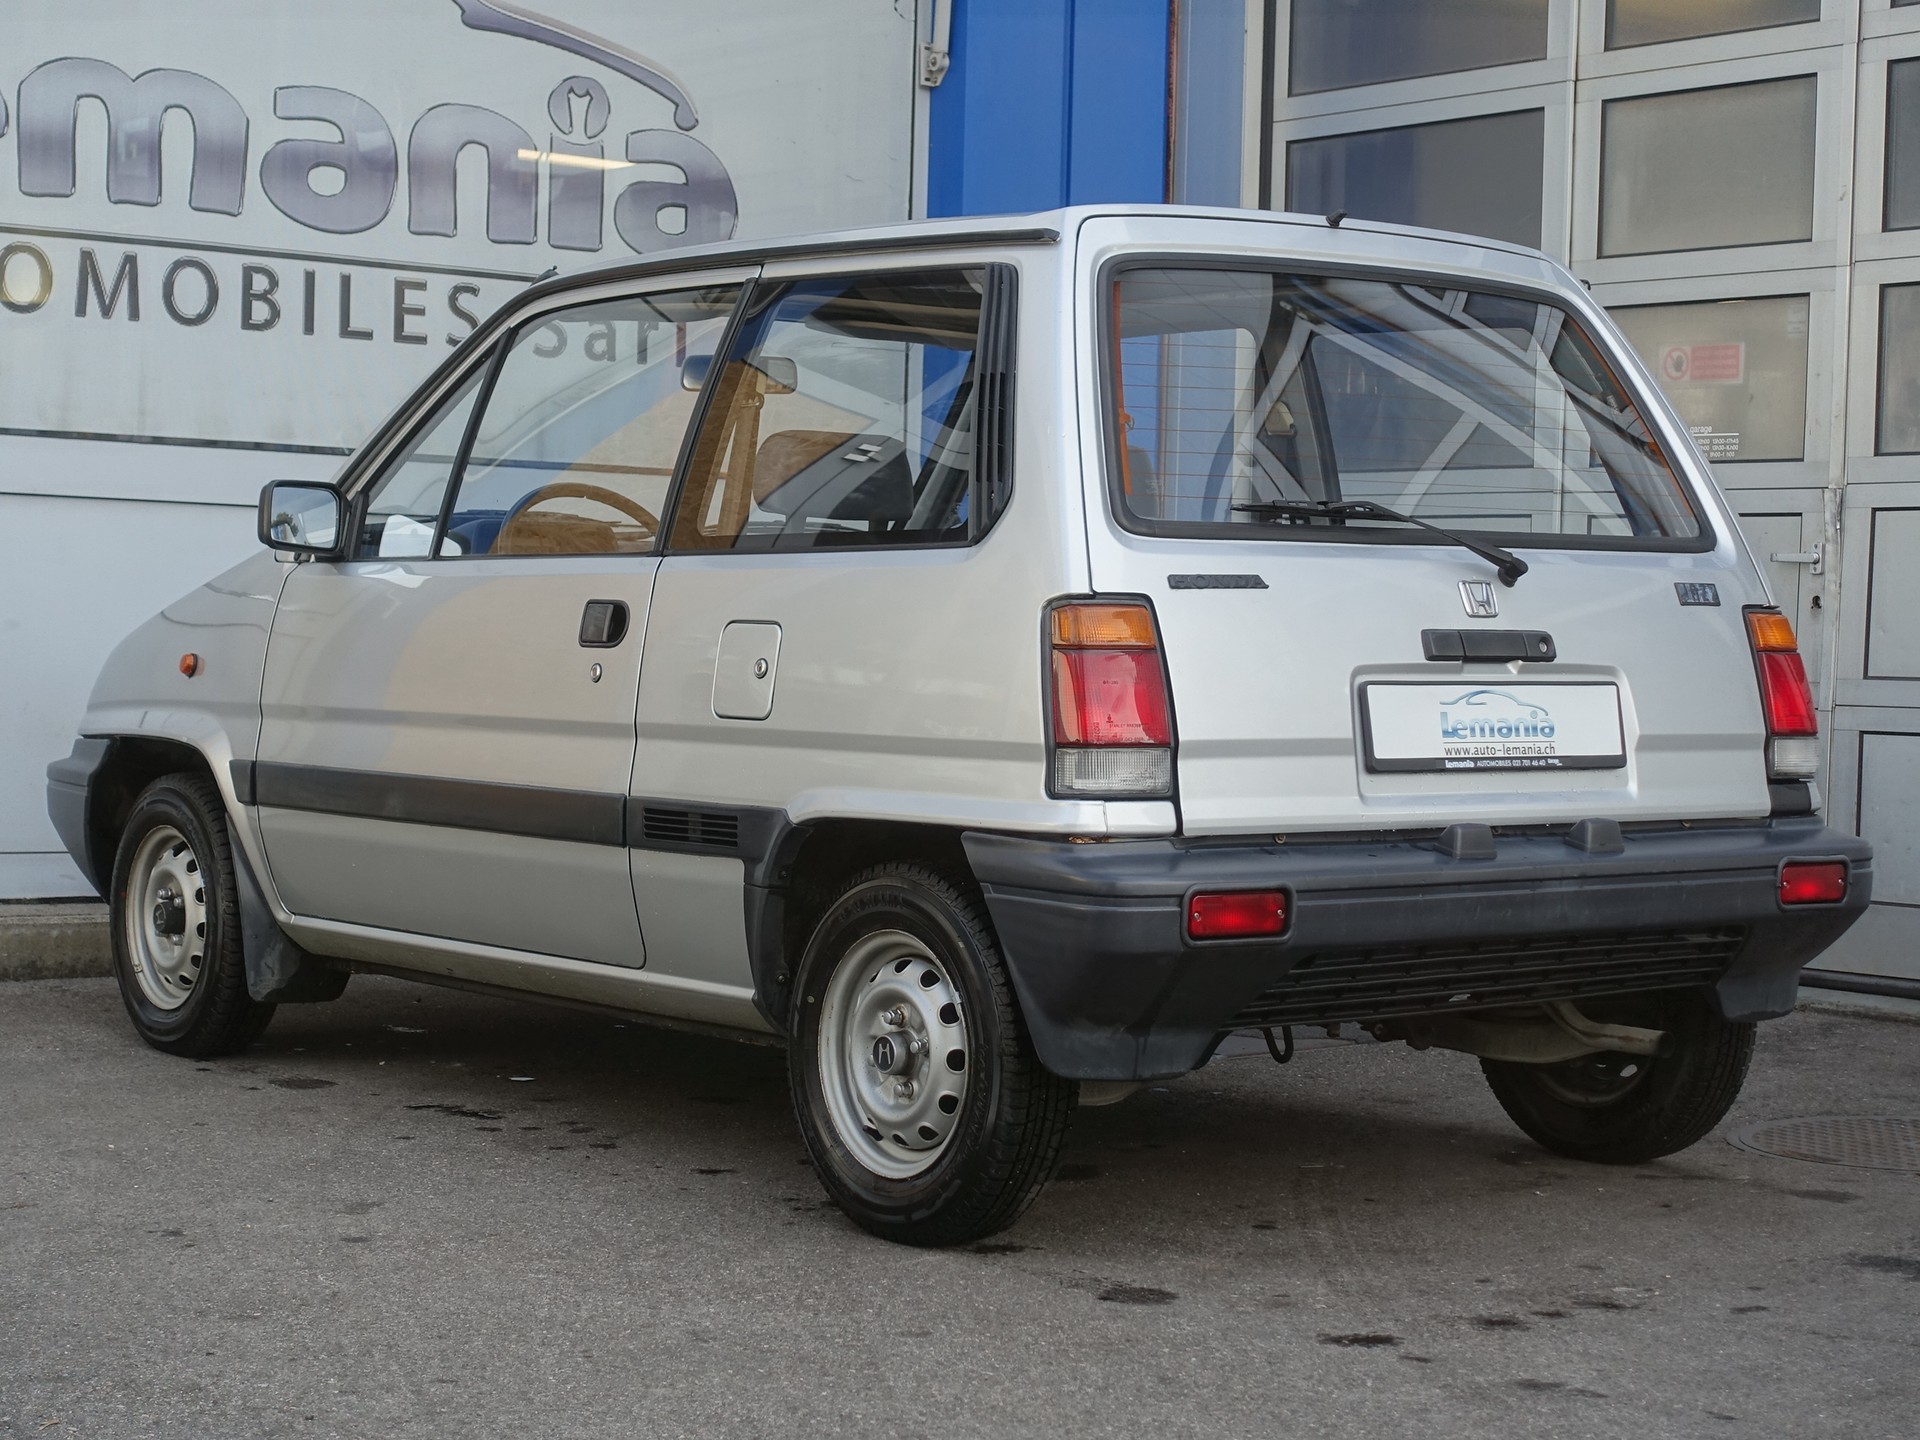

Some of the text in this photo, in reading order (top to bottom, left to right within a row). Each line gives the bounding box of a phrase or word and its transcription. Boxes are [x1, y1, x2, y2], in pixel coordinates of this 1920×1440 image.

[0, 57, 738, 256] mania
[1440, 711, 1555, 739] Lemania
[1444, 743, 1556, 756] www.auto-lemania.ch
